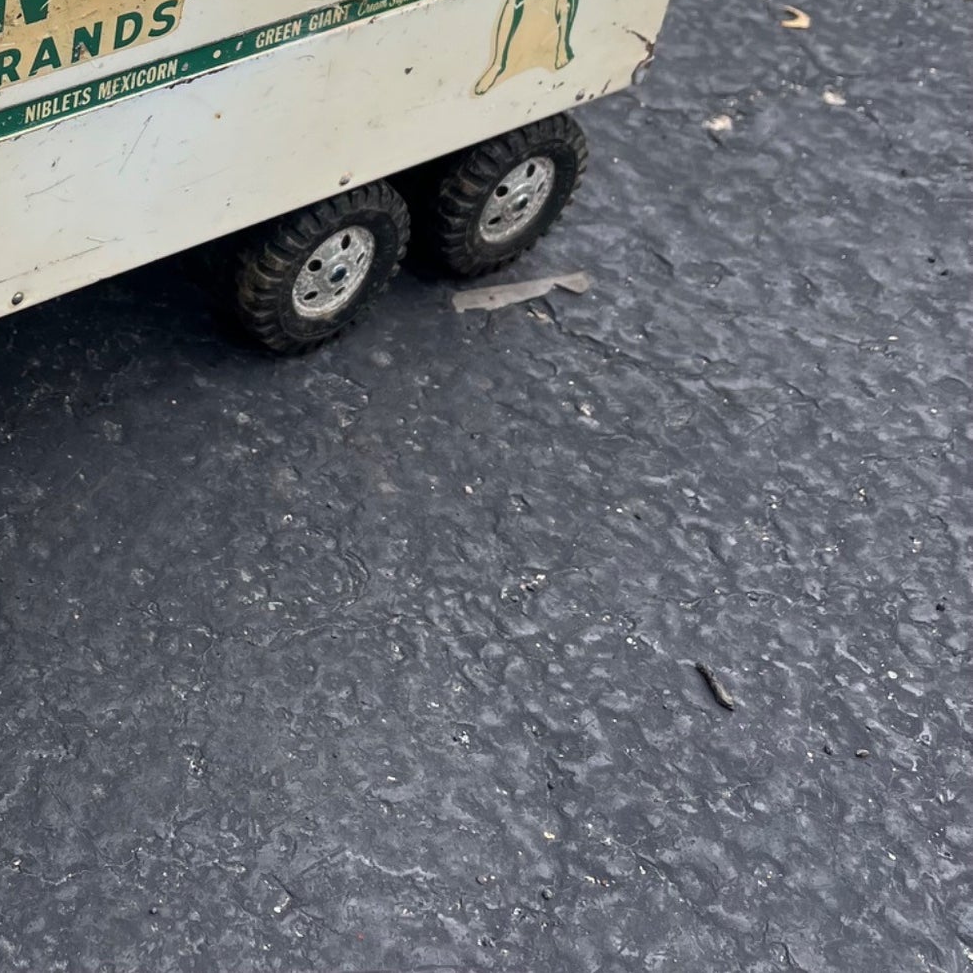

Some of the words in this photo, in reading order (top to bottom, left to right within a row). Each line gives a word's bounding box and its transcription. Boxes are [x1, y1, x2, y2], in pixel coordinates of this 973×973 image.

[255, 19, 302, 49] GREEN
[308, 3, 352, 31] GIANT
[24, 87, 91, 124] NIBLETS
[97, 59, 179, 100] MEXICORN
